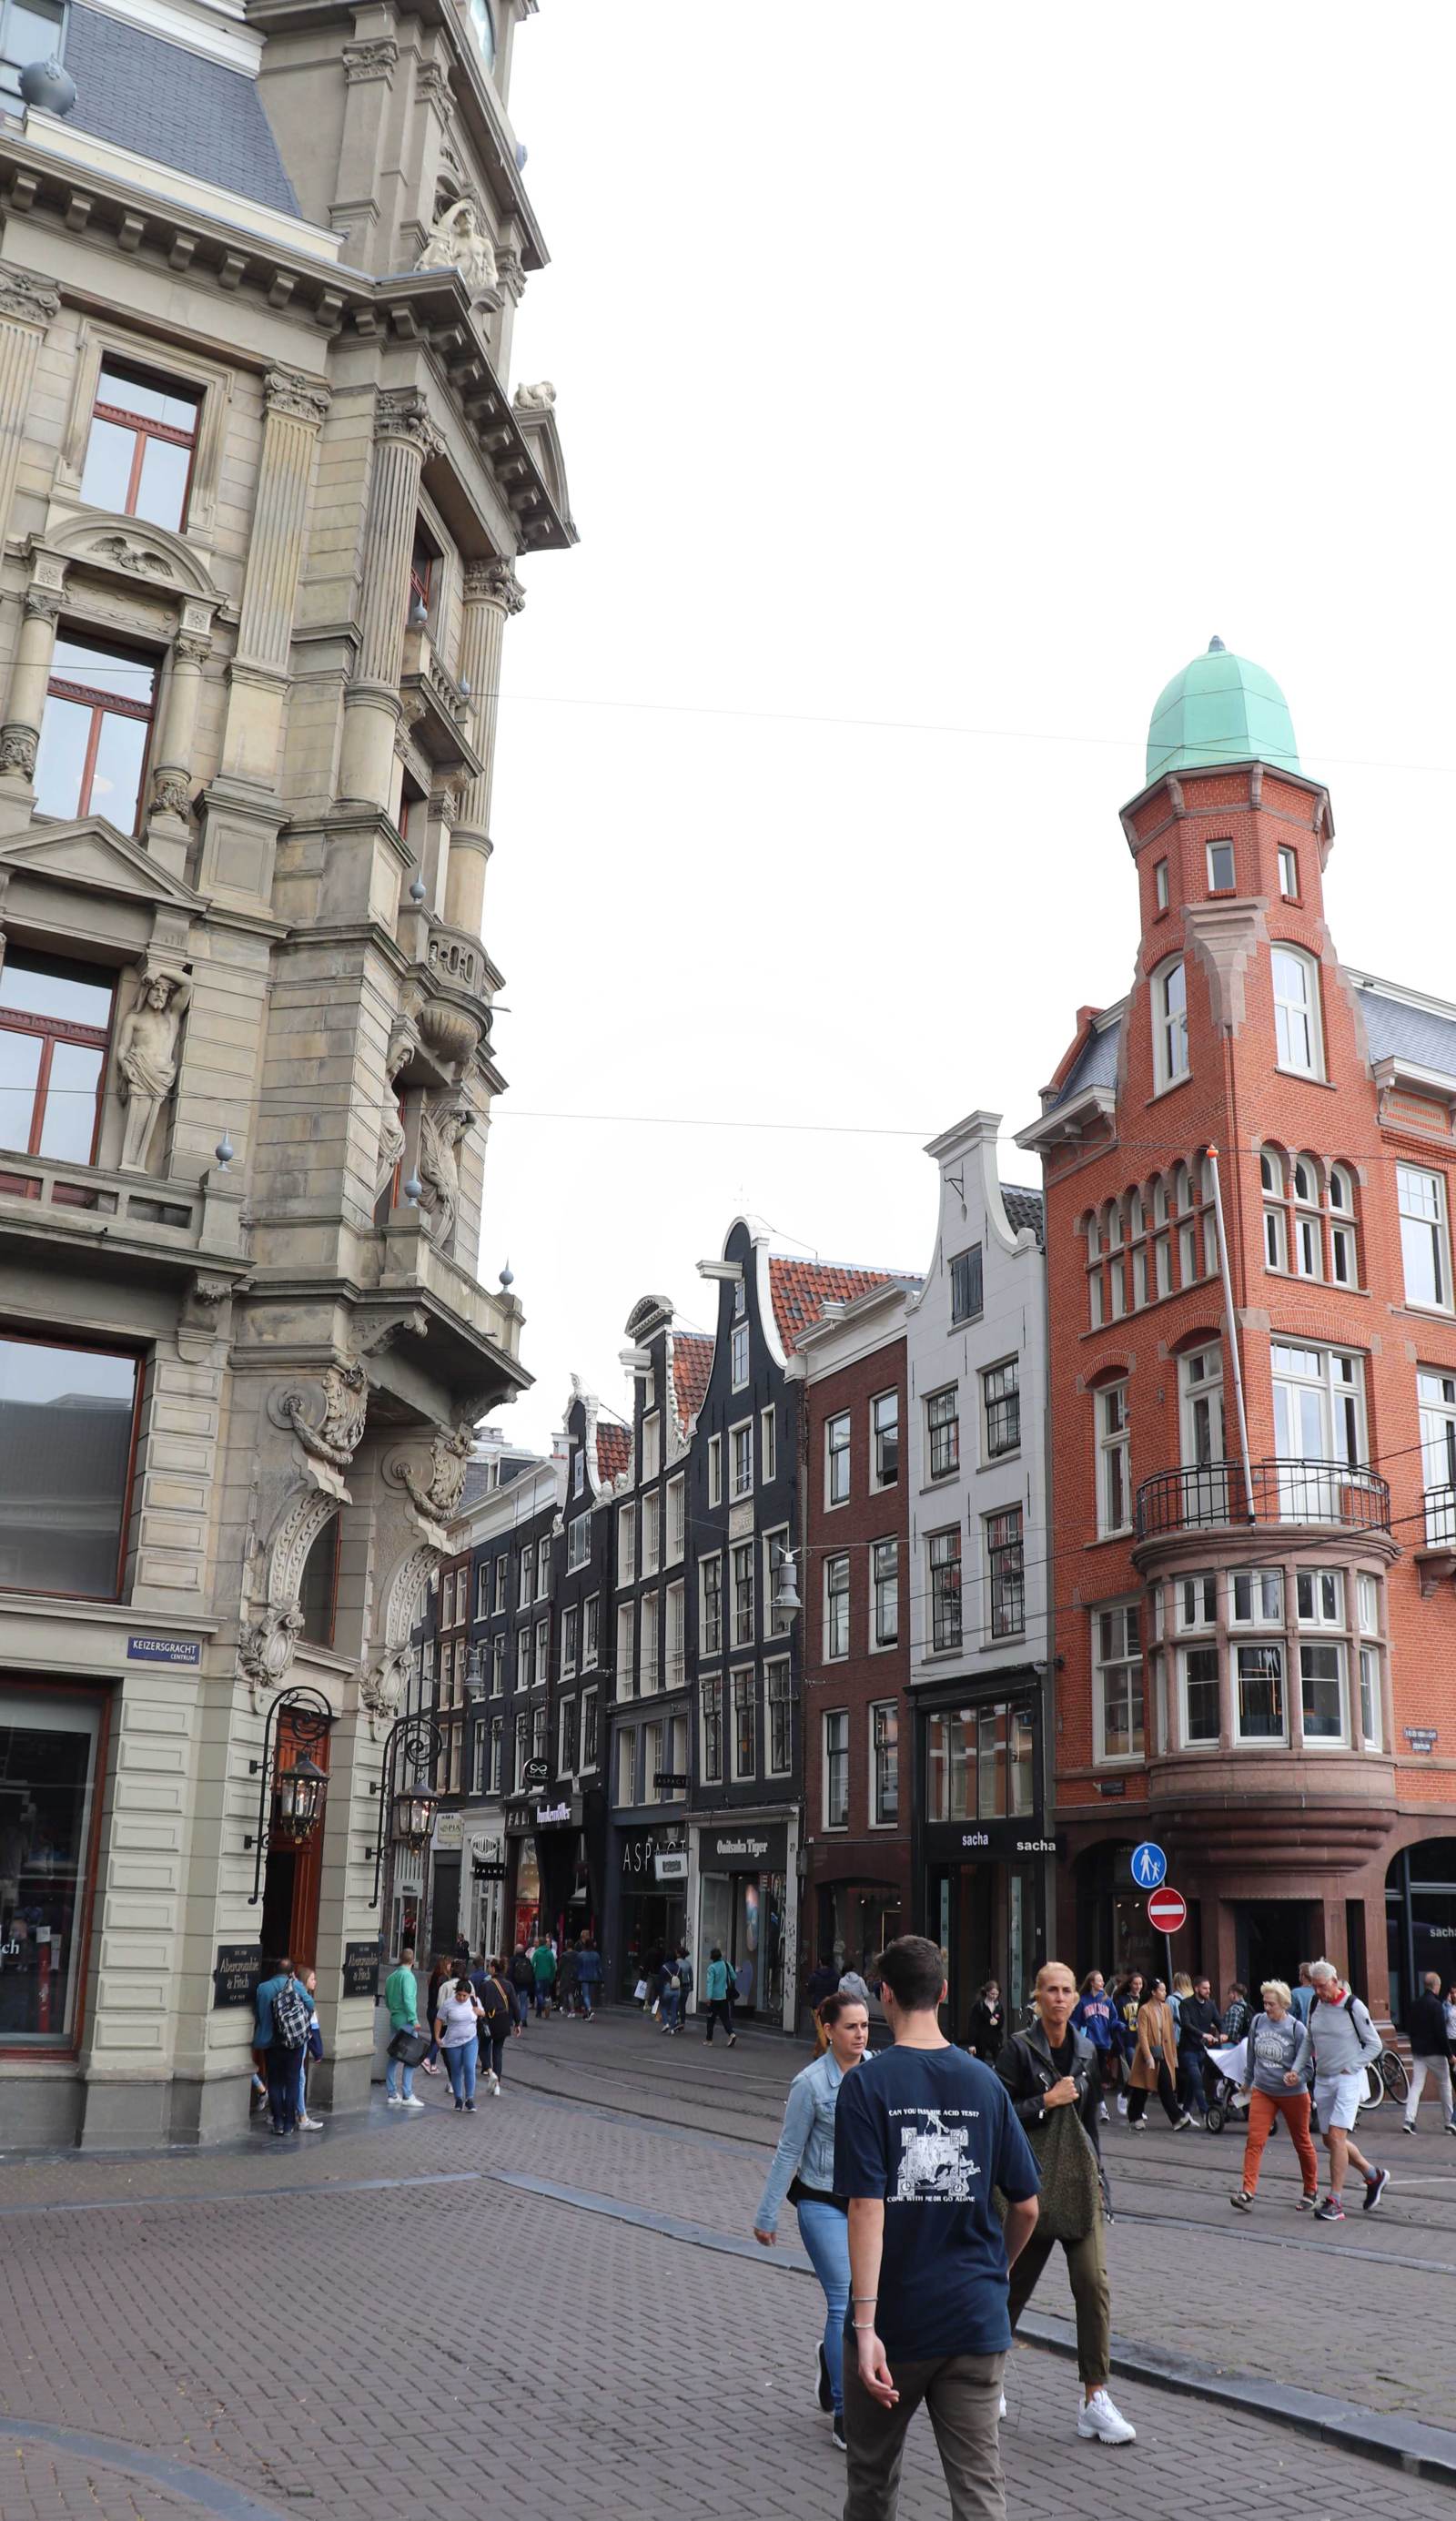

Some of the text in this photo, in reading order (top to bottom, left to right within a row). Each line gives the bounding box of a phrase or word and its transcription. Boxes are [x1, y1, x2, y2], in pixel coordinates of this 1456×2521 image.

[133, 1640, 197, 1654] KEIZERSGRACHT
[962, 1831, 988, 1846] sacha
[1016, 1839, 1056, 1851] sacha
[717, 1838, 768, 1858] Onitsuka Tiger
[0, 1939, 20, 1954] ch
[961, 2110, 980, 2118] TEST?
